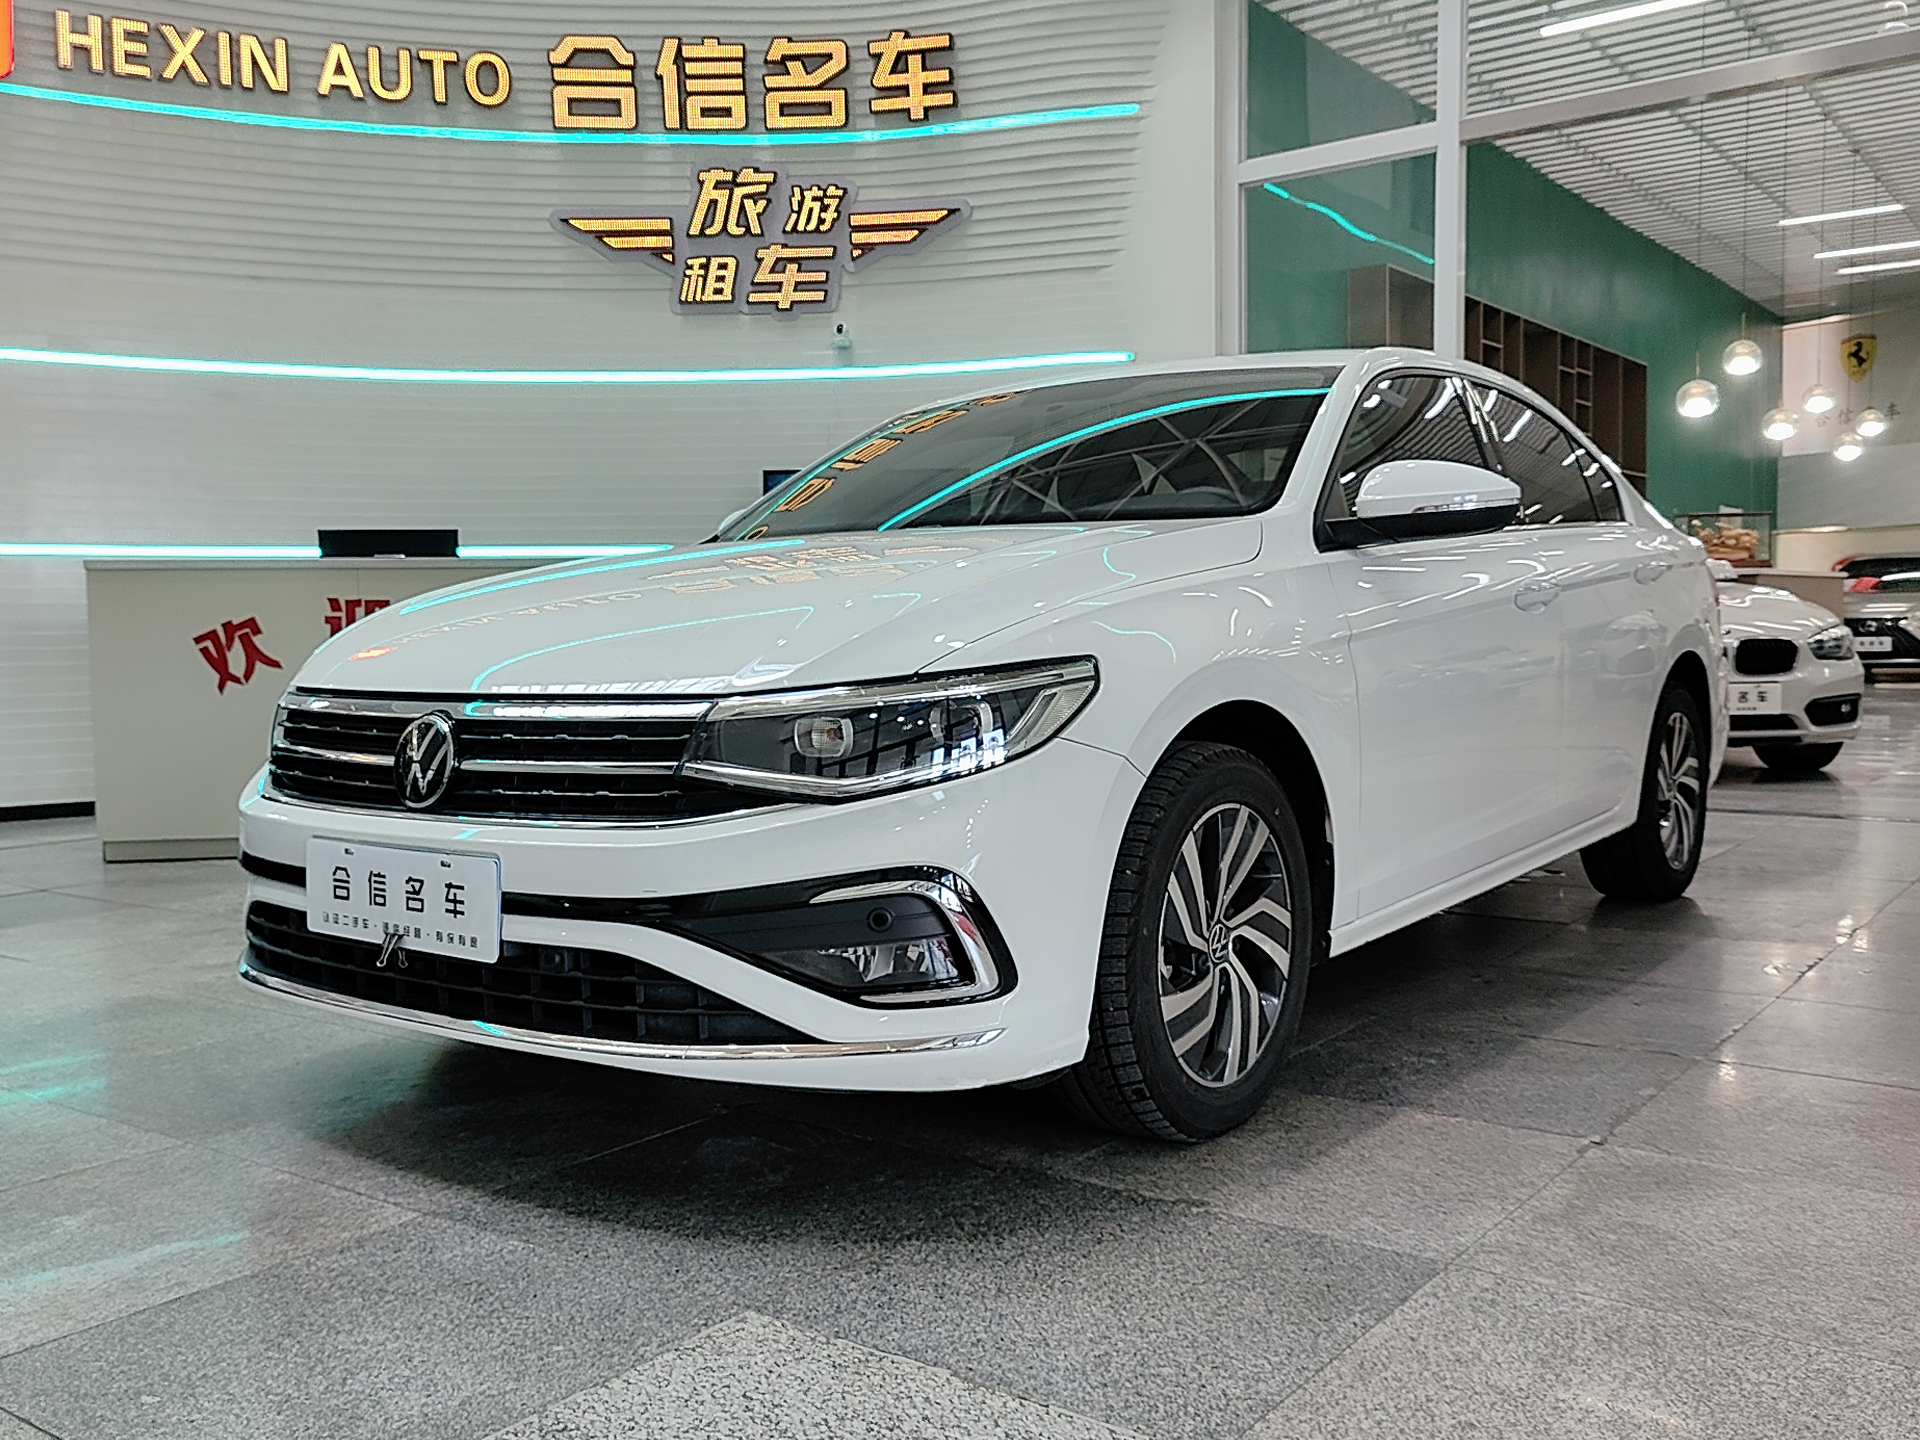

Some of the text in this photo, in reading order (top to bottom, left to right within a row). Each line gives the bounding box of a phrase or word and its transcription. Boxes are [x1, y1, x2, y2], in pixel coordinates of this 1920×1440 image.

[54, 9, 513, 107] HEXIN AUTO
[548, 31, 955, 131] 合信名车
[686, 167, 849, 238] 旅游
[678, 244, 834, 310] 租车
[332, 866, 466, 919] 合信名车
